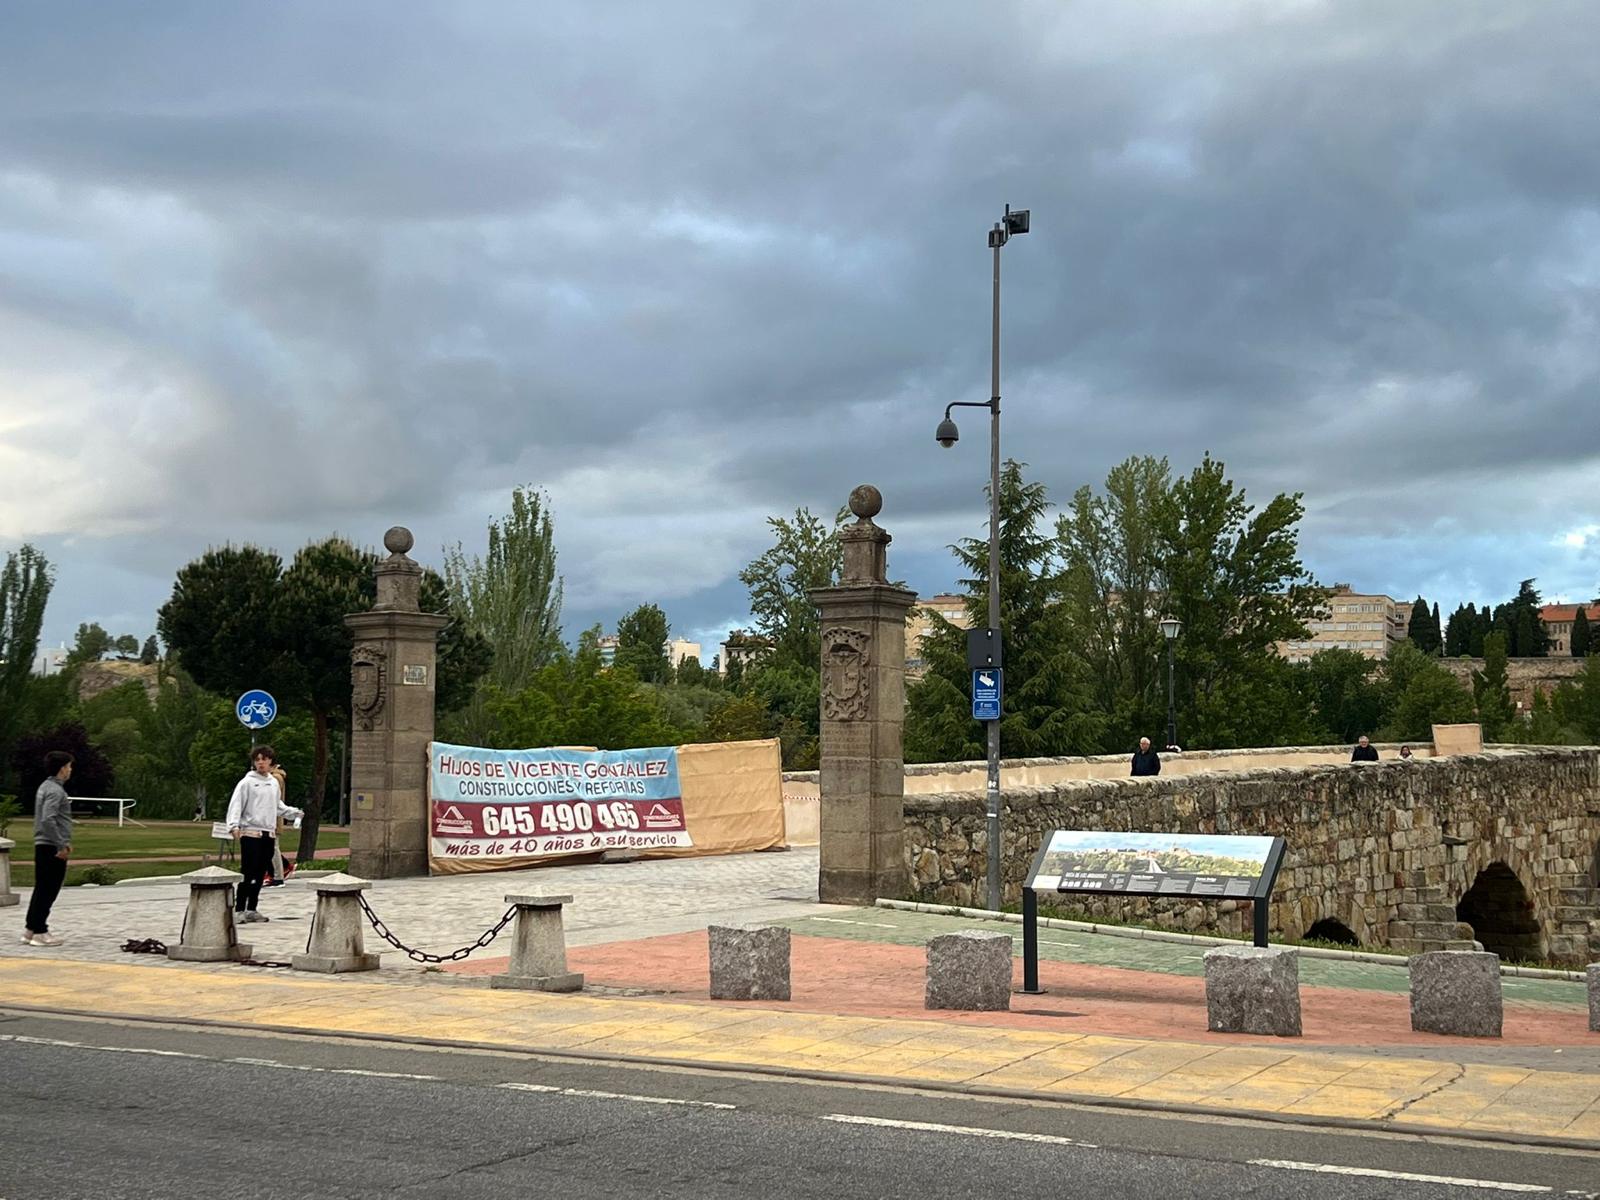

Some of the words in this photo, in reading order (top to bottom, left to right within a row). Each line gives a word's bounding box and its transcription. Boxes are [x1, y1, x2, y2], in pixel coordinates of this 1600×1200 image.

[440, 756, 481, 777] HIJOS
[485, 763, 505, 778] DE
[508, 761, 582, 778] VICENTE
[459, 781, 575, 796] CONSTRUCCIONES
[574, 782, 581, 791] Y
[482, 806, 535, 836] 645
[541, 802, 593, 832] 490
[597, 801, 640, 829] 465
[445, 840, 480, 855] más
[486, 841, 505, 855] de
[509, 839, 538, 853] 40
[544, 835, 584, 851] años
[590, 836, 600, 847] a
[606, 835, 627, 845] su
[629, 834, 677, 846] servicio
